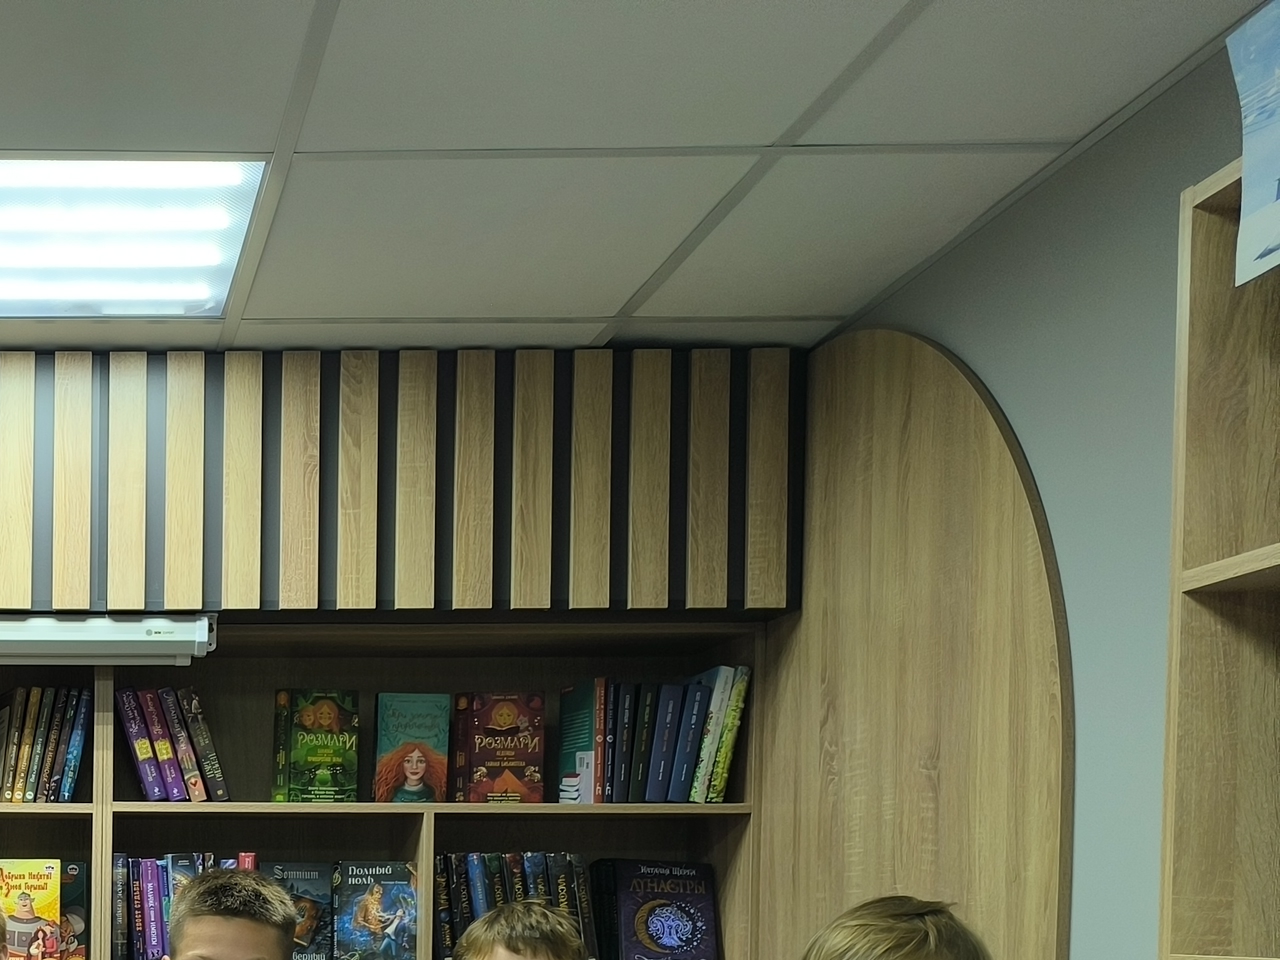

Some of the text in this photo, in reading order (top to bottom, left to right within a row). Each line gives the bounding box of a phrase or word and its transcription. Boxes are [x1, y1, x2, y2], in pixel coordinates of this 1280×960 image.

[297, 731, 356, 750] РОЗМАРИ
[474, 734, 540, 753] РОЗМАРИ
[273, 865, 319, 880] Somnium
[348, 865, 393, 876] Полный
[629, 878, 706, 895] ЛУНАСТРЫ
